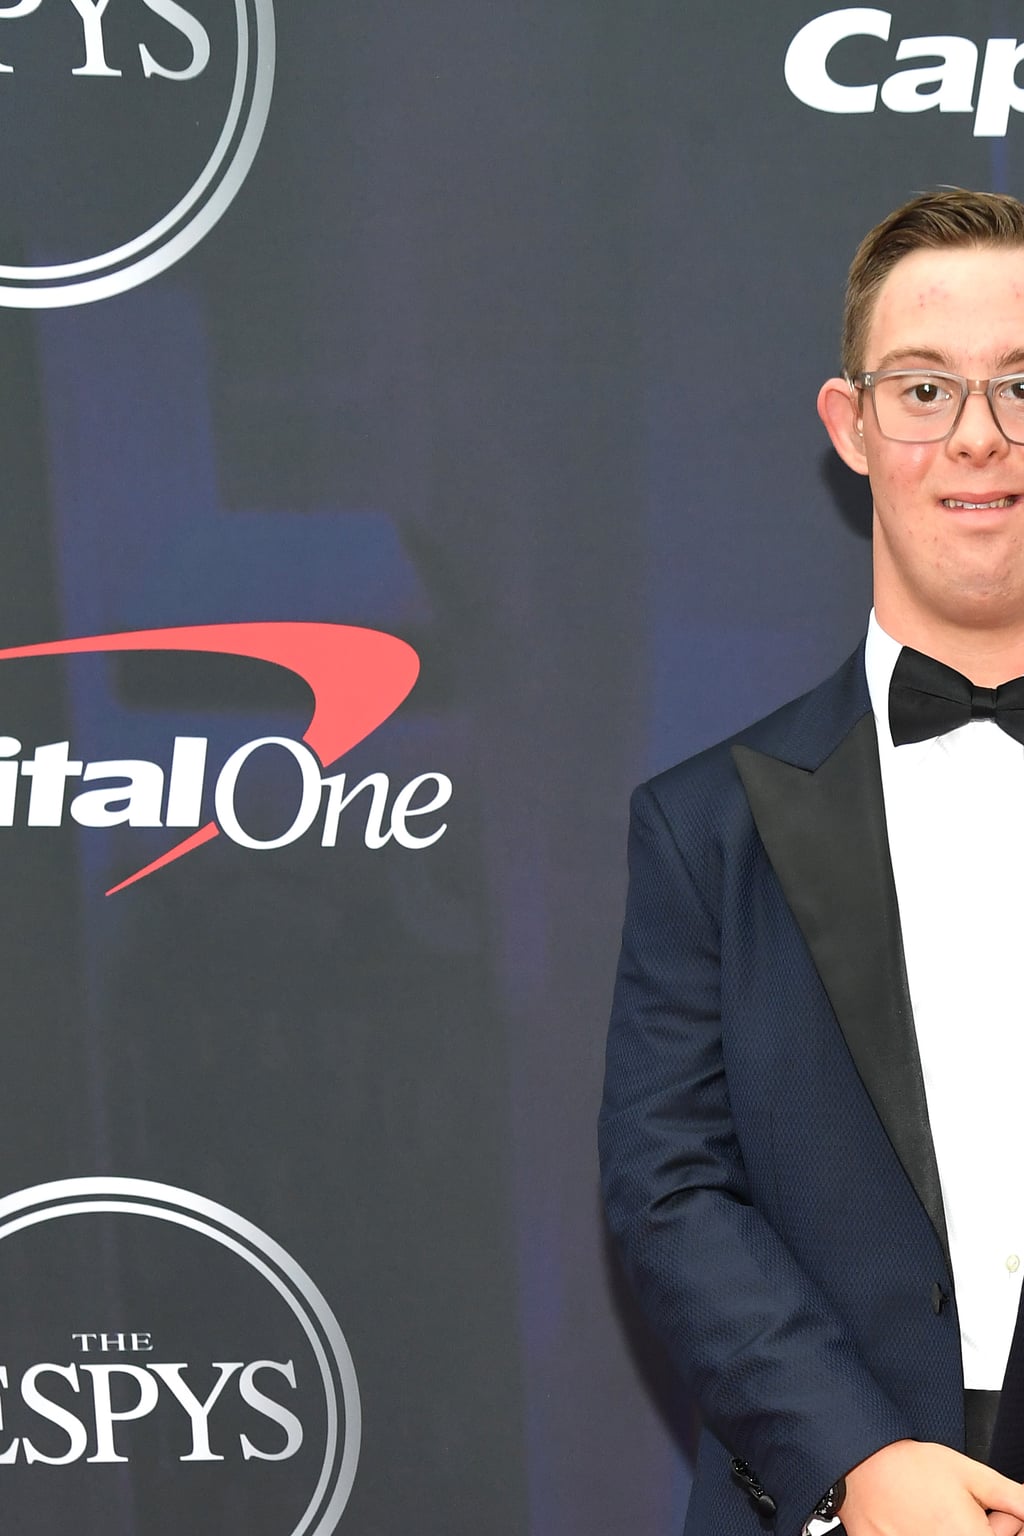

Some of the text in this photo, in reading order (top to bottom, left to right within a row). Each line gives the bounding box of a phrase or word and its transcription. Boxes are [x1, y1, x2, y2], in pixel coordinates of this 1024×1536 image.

[0, 0, 211, 80] YS
[71, 1333, 153, 1352] THE
[0, 1359, 304, 1466] SPYS
